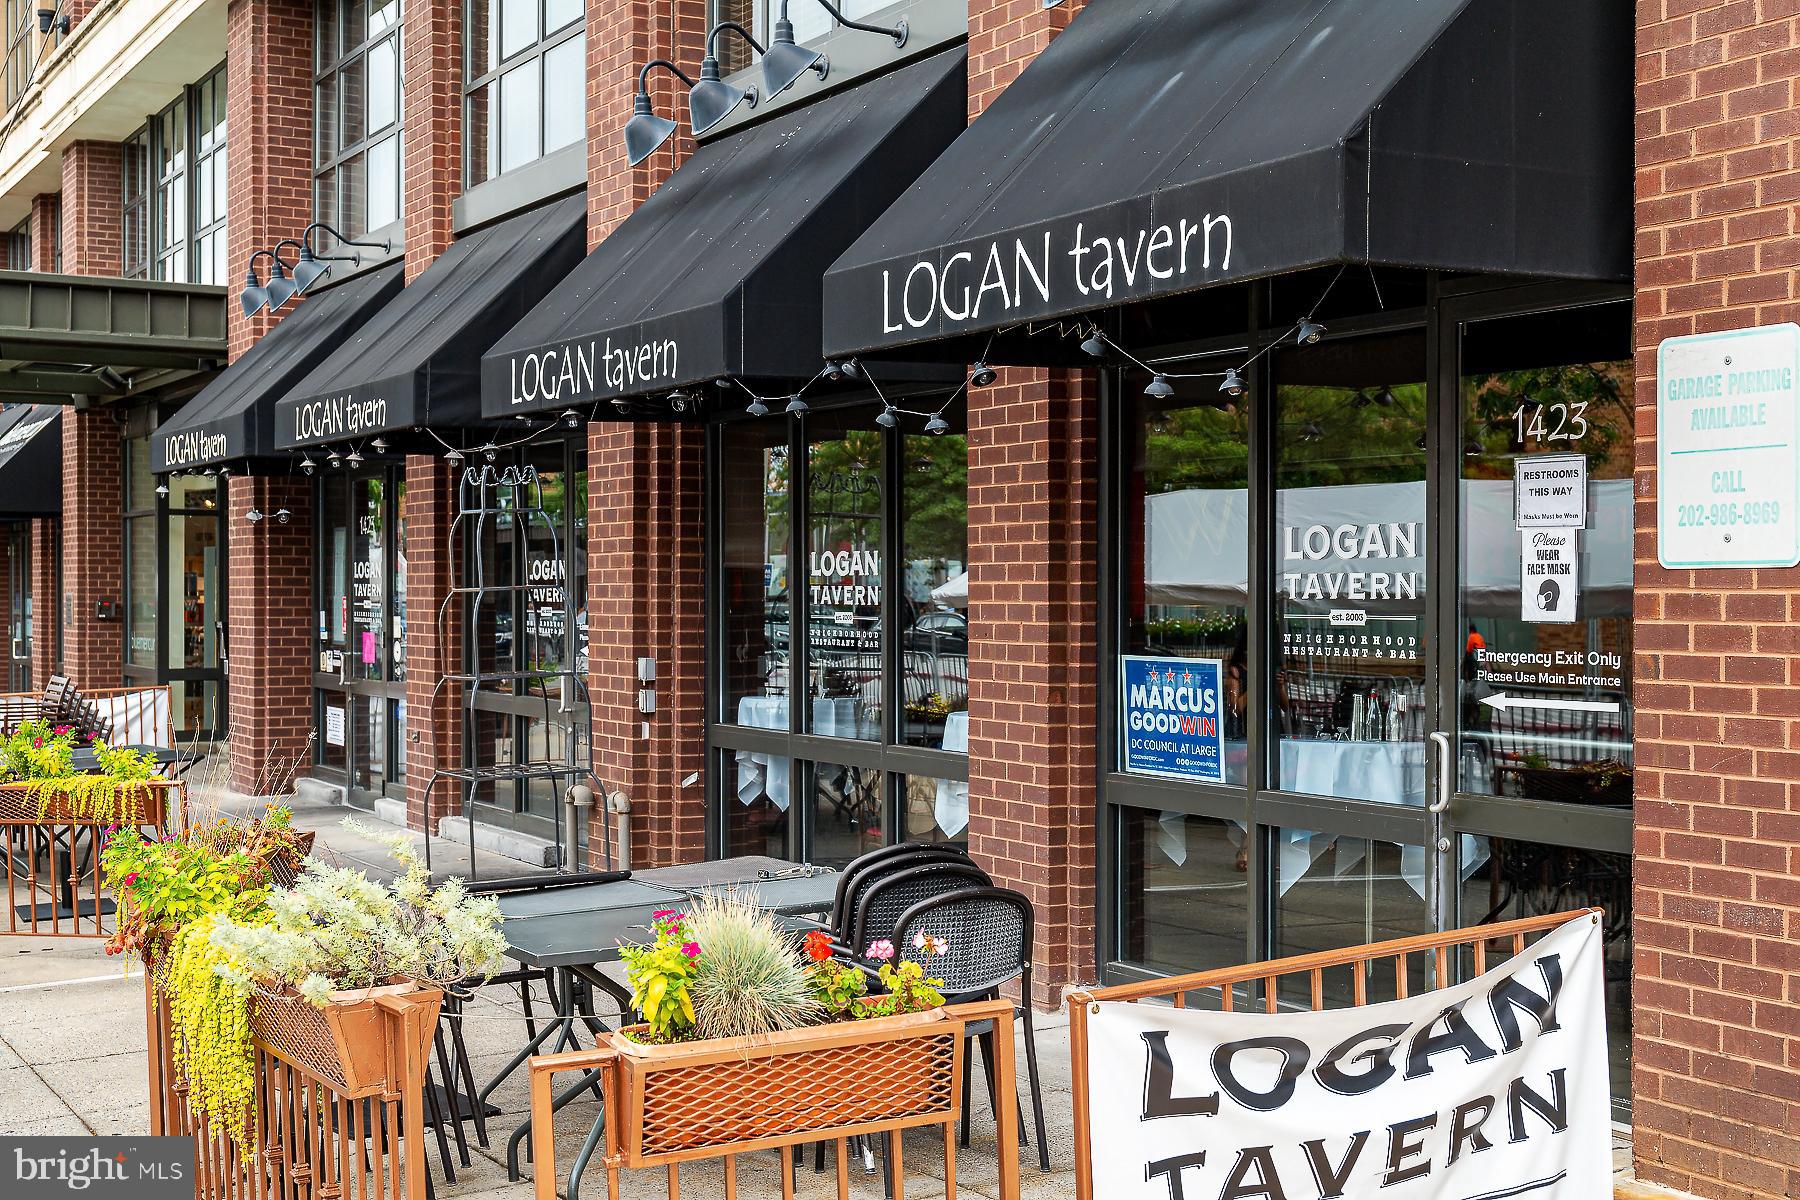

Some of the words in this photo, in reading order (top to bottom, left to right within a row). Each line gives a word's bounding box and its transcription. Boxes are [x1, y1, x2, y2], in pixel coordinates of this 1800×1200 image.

[883, 231, 1051, 334] LOGAN
[1068, 213, 1233, 299] tavern
[511, 341, 595, 404] LOGAN
[602, 336, 678, 392] tavern
[1667, 374, 1723, 401] GARAGE
[1728, 367, 1792, 396] PARKING
[295, 397, 344, 440] LOGAN
[346, 395, 387, 433] tavern
[1512, 401, 1589, 443] 1423
[1691, 403, 1766, 431] AVAILABLE
[165, 432, 199, 466] LOGAN
[199, 430, 227, 461] tavern
[1523, 469, 1579, 480] RESTROOMS
[1711, 470, 1746, 493] CALL
[1528, 487, 1550, 497] THIS
[1552, 486, 1573, 496] WAY
[1678, 501, 1781, 527] 202-986-8969
[1283, 523, 1420, 560] LOGAN
[1532, 532, 1567, 548] Please
[811, 550, 879, 577] LOGAN
[1536, 549, 1560, 561] WEAR
[353, 561, 382, 579] LOGAN
[1527, 563, 1546, 576] FACE
[1547, 563, 1571, 575] MASK
[353, 583, 382, 597] TAVERN
[810, 585, 879, 606] TAVERN
[1283, 572, 1417, 600] TAVERN
[1331, 613, 1344, 621] est.
[1345, 613, 1364, 622] 2003
[1283, 633, 1417, 646] NEIGHBORHOOD
[1283, 646, 1369, 658] RESTAURANT
[1375, 648, 1383, 659] &
[1389, 649, 1417, 660] BAR
[1476, 648, 1552, 667] Emergency
[1555, 651, 1584, 665] Exit
[1587, 652, 1621, 669] Only
[1476, 670, 1513, 682] Please
[1515, 671, 1536, 683] Use
[1538, 672, 1565, 684] Main
[1568, 674, 1621, 686] Entrance
[1130, 683, 1216, 714] MARCUS
[1130, 711, 1217, 738] GOODWIN
[1131, 738, 1142, 749] DC
[1144, 739, 1179, 753] COUNCIL
[1180, 742, 1190, 754] AT
[1191, 743, 1217, 757] LARGE
[1140, 953, 1564, 1122] LOGAN
[1145, 1067, 1569, 1200] TAVERN
